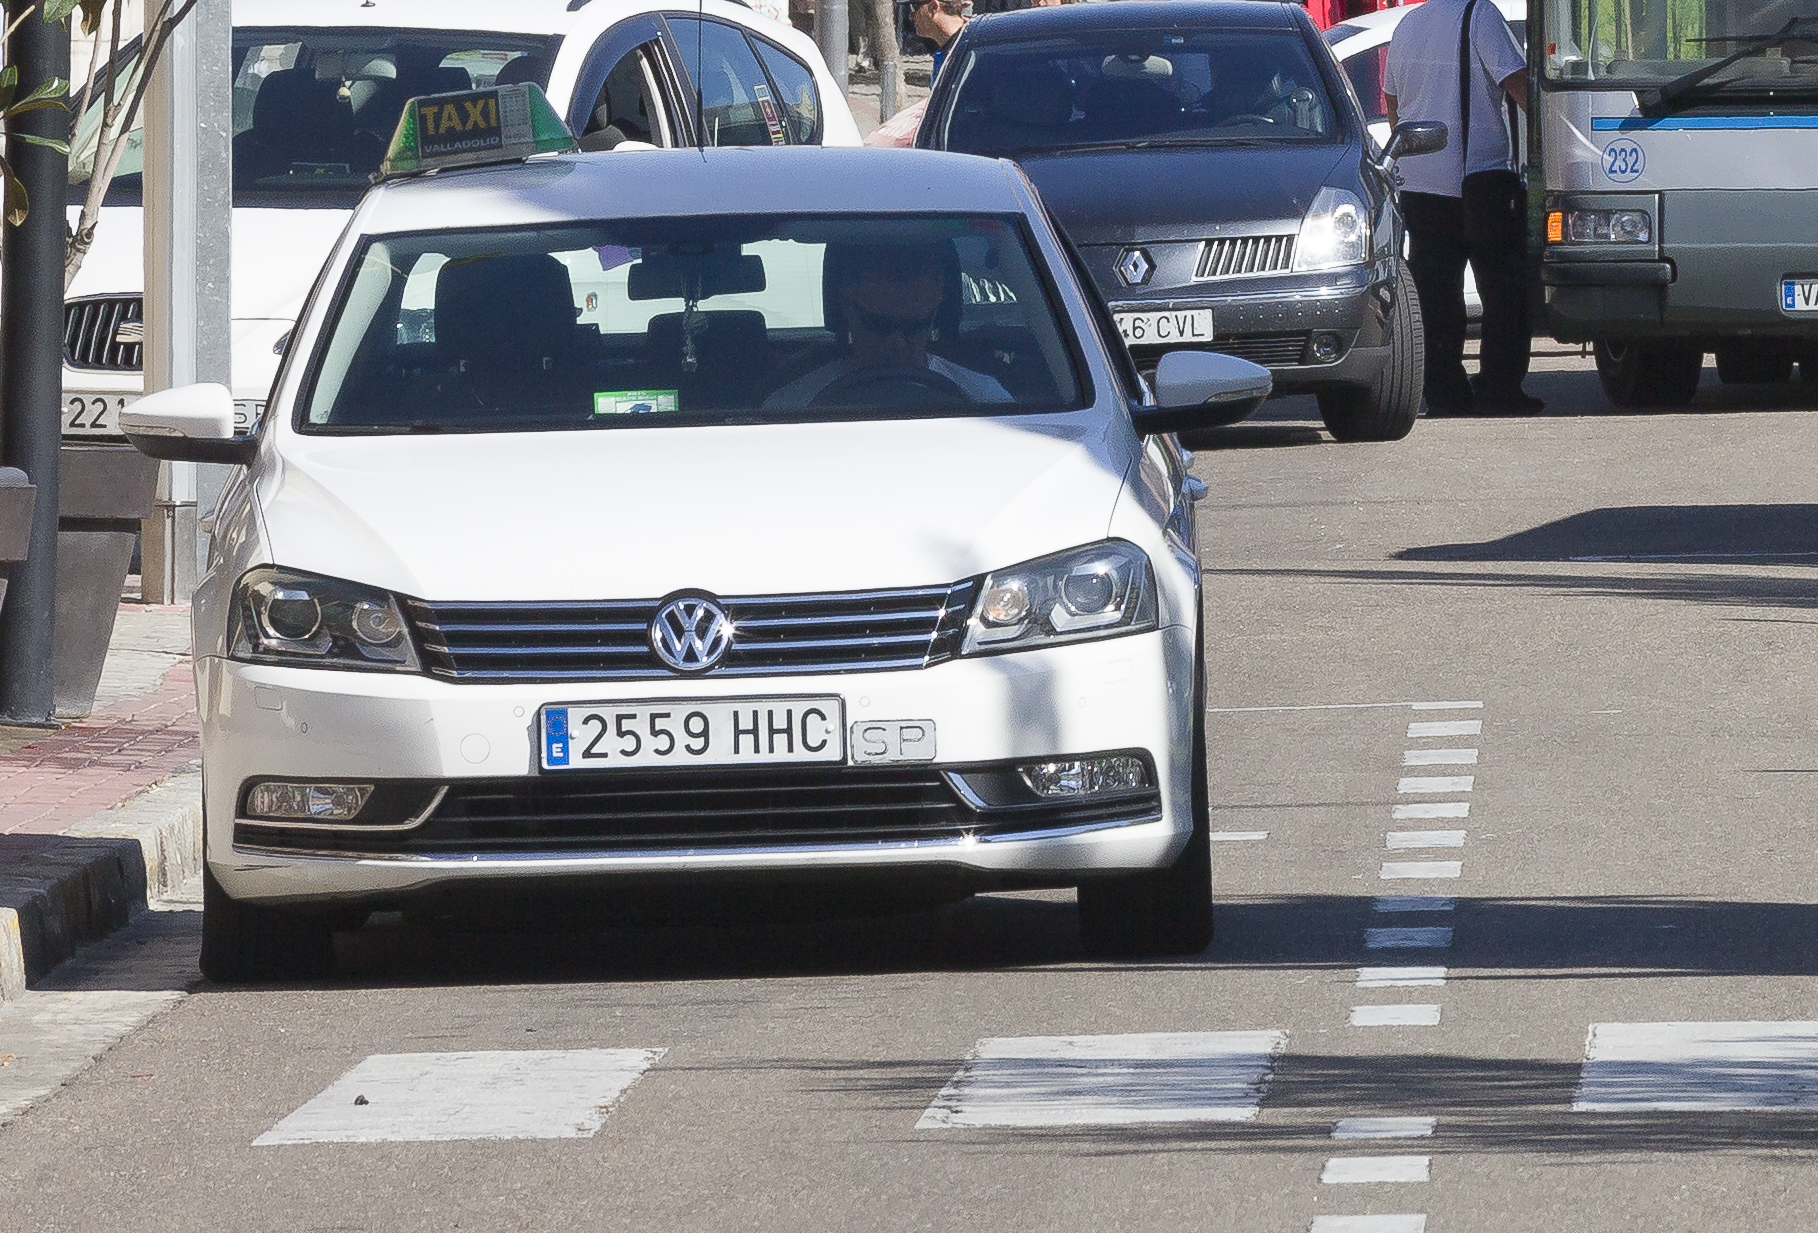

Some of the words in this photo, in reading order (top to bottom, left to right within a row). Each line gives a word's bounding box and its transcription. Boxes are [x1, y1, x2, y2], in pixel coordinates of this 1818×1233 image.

[420, 98, 498, 135] TAXI
[424, 136, 500, 153] VALLADOLID
[1608, 147, 1639, 174] 232
[1157, 314, 1205, 339] CVL
[552, 743, 564, 758] E
[581, 711, 710, 759] 2559
[733, 707, 828, 755] HHC
[862, 725, 925, 756] SP
